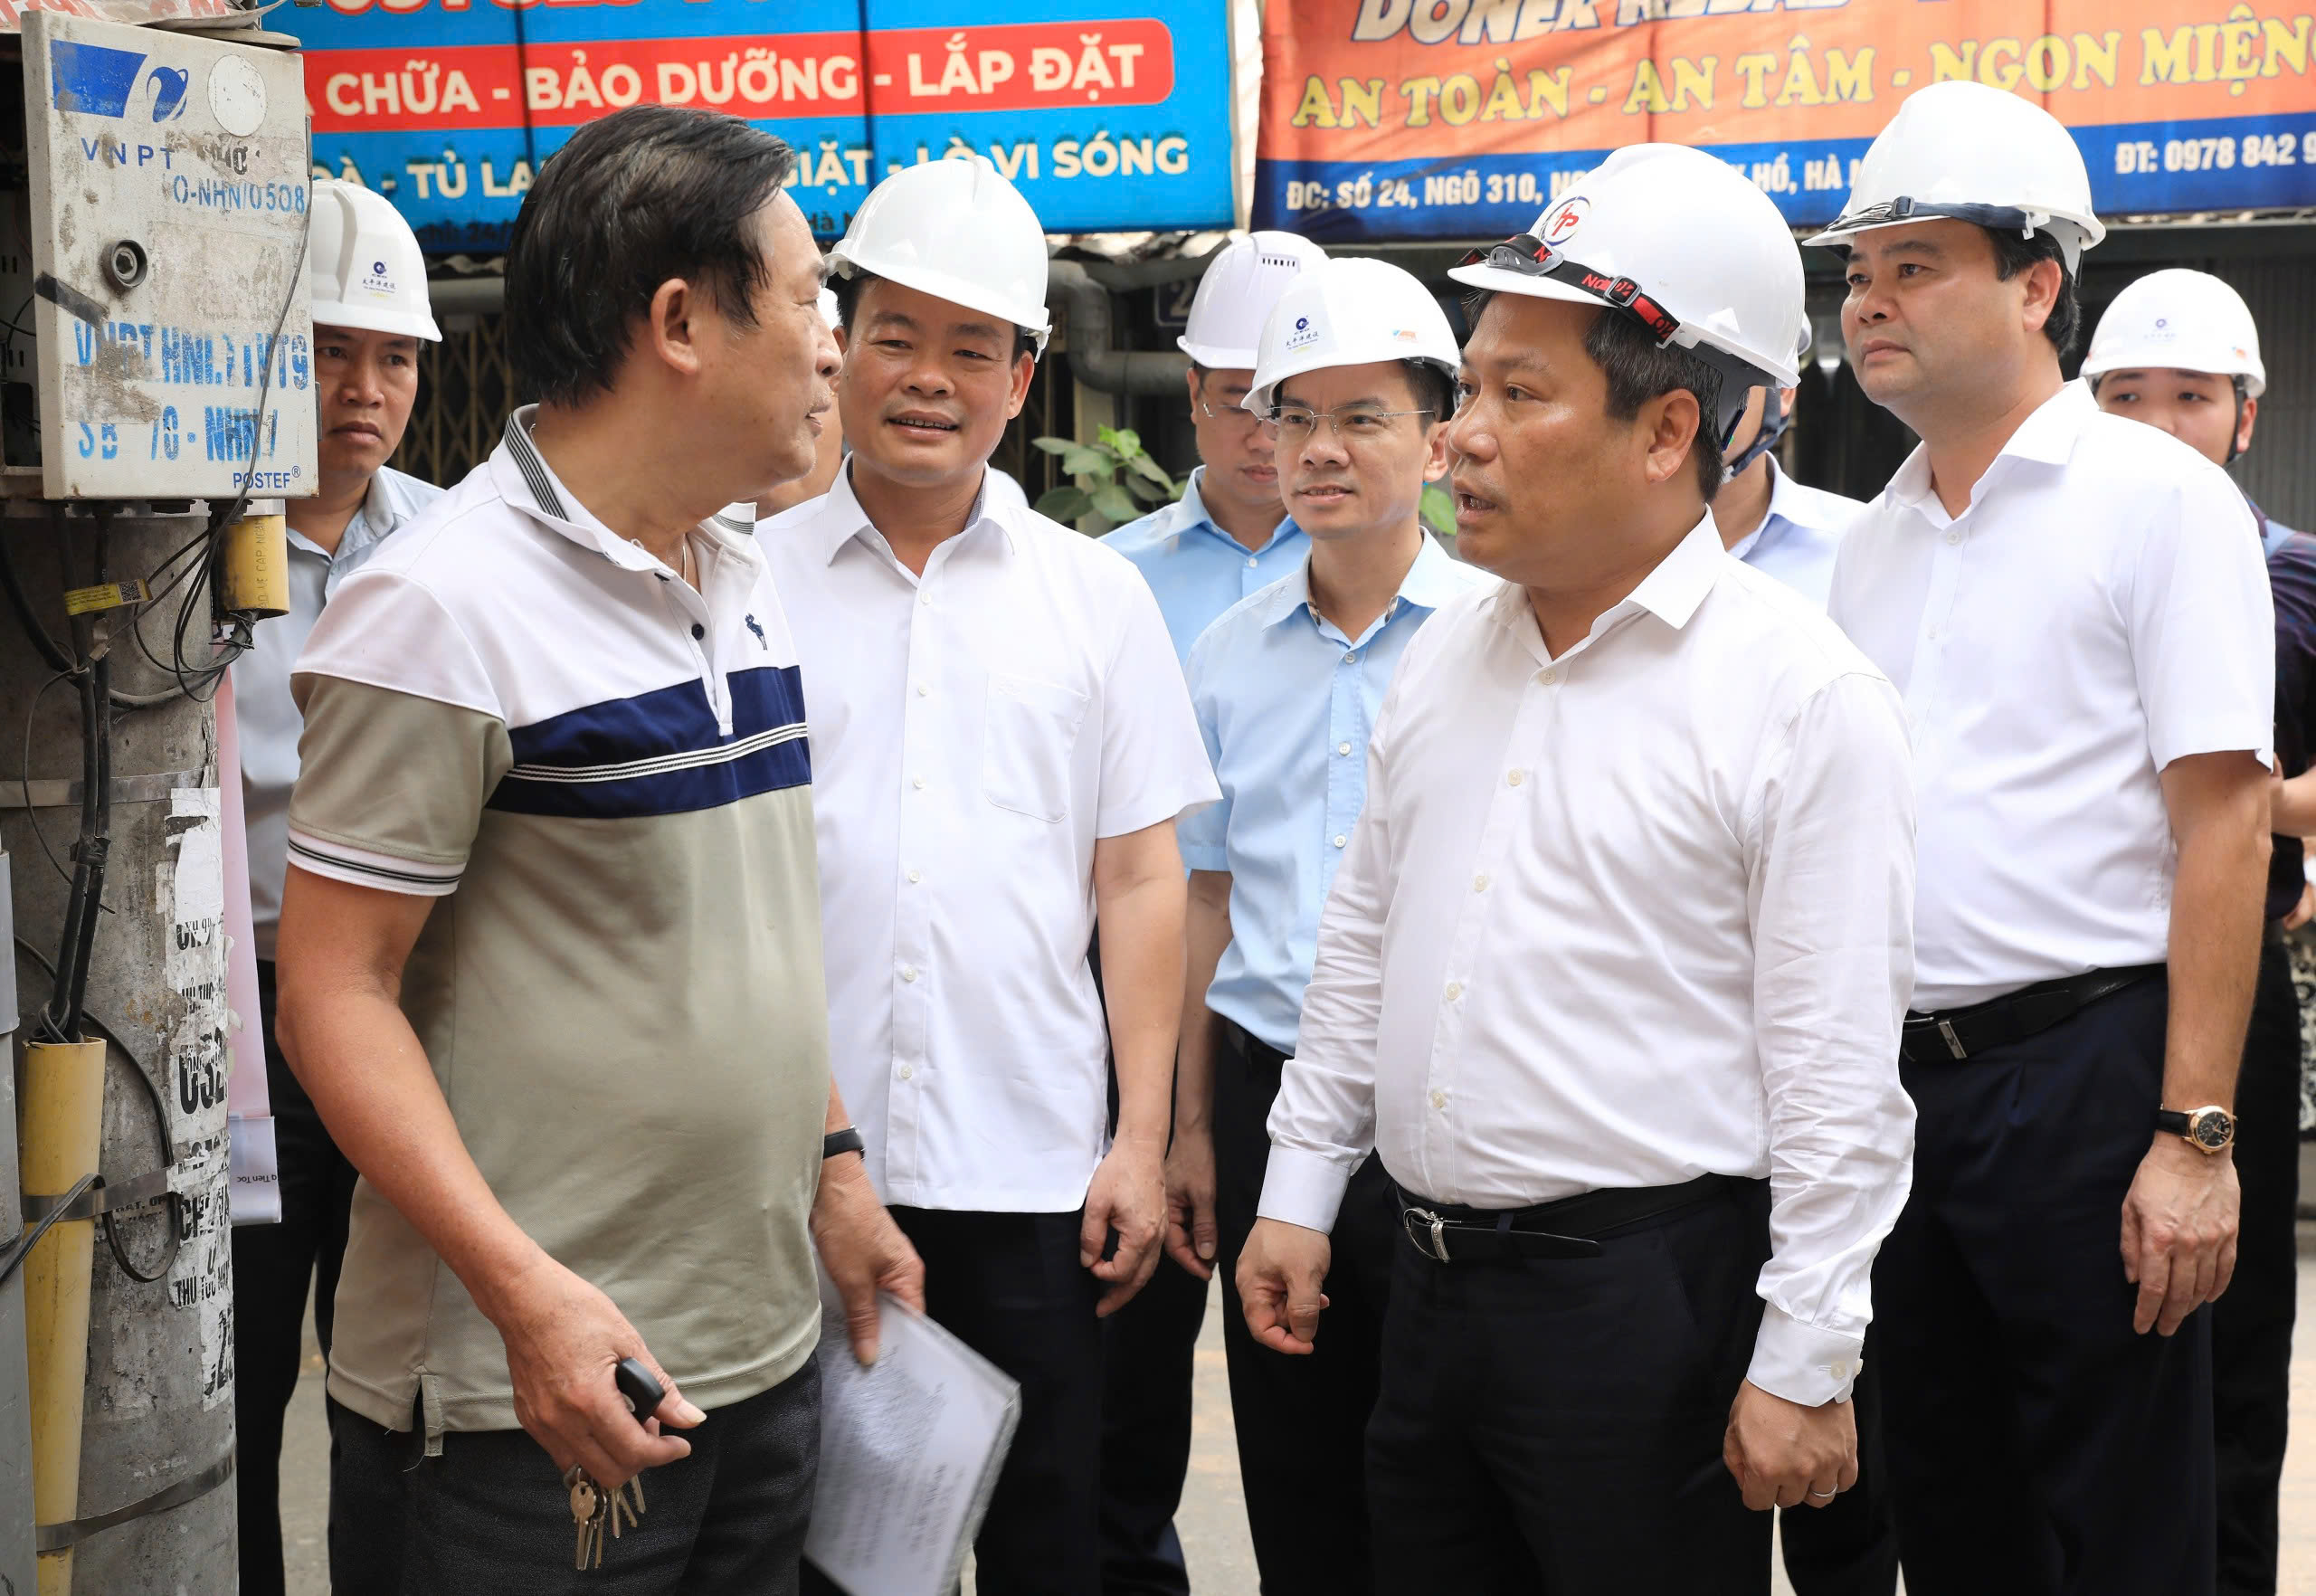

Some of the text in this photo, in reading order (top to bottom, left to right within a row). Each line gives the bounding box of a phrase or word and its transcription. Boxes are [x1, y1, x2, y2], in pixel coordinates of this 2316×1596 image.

[326, 60, 479, 116] CHỮA
[527, 50, 642, 109] BẢO
[657, 47, 858, 105] DƯỠNG
[907, 33, 1015, 97] LẮP
[1029, 33, 1144, 101] ĐẶT
[1291, 75, 1385, 128] AN
[1400, 57, 1573, 128] TOÀN
[1622, 55, 1718, 114] AN
[1735, 33, 1876, 109] TÂM
[1929, 30, 2123, 92] NGON
[2139, 3, 2316, 97] MIỆN
[81, 138, 175, 170] VNPT
[406, 149, 468, 199] TỦ
[991, 143, 1039, 180] VI
[1052, 131, 1188, 178] SÓNG
[1336, 172, 1372, 209] SỐ
[1377, 179, 1418, 209] 24,
[1424, 169, 1480, 205] NGÕ
[1486, 172, 1543, 204] 310,
[1804, 153, 1843, 191] HÀ
[2114, 141, 2159, 175] ĐT:
[2163, 137, 2236, 173] 0978
[2241, 133, 2297, 168] 842
